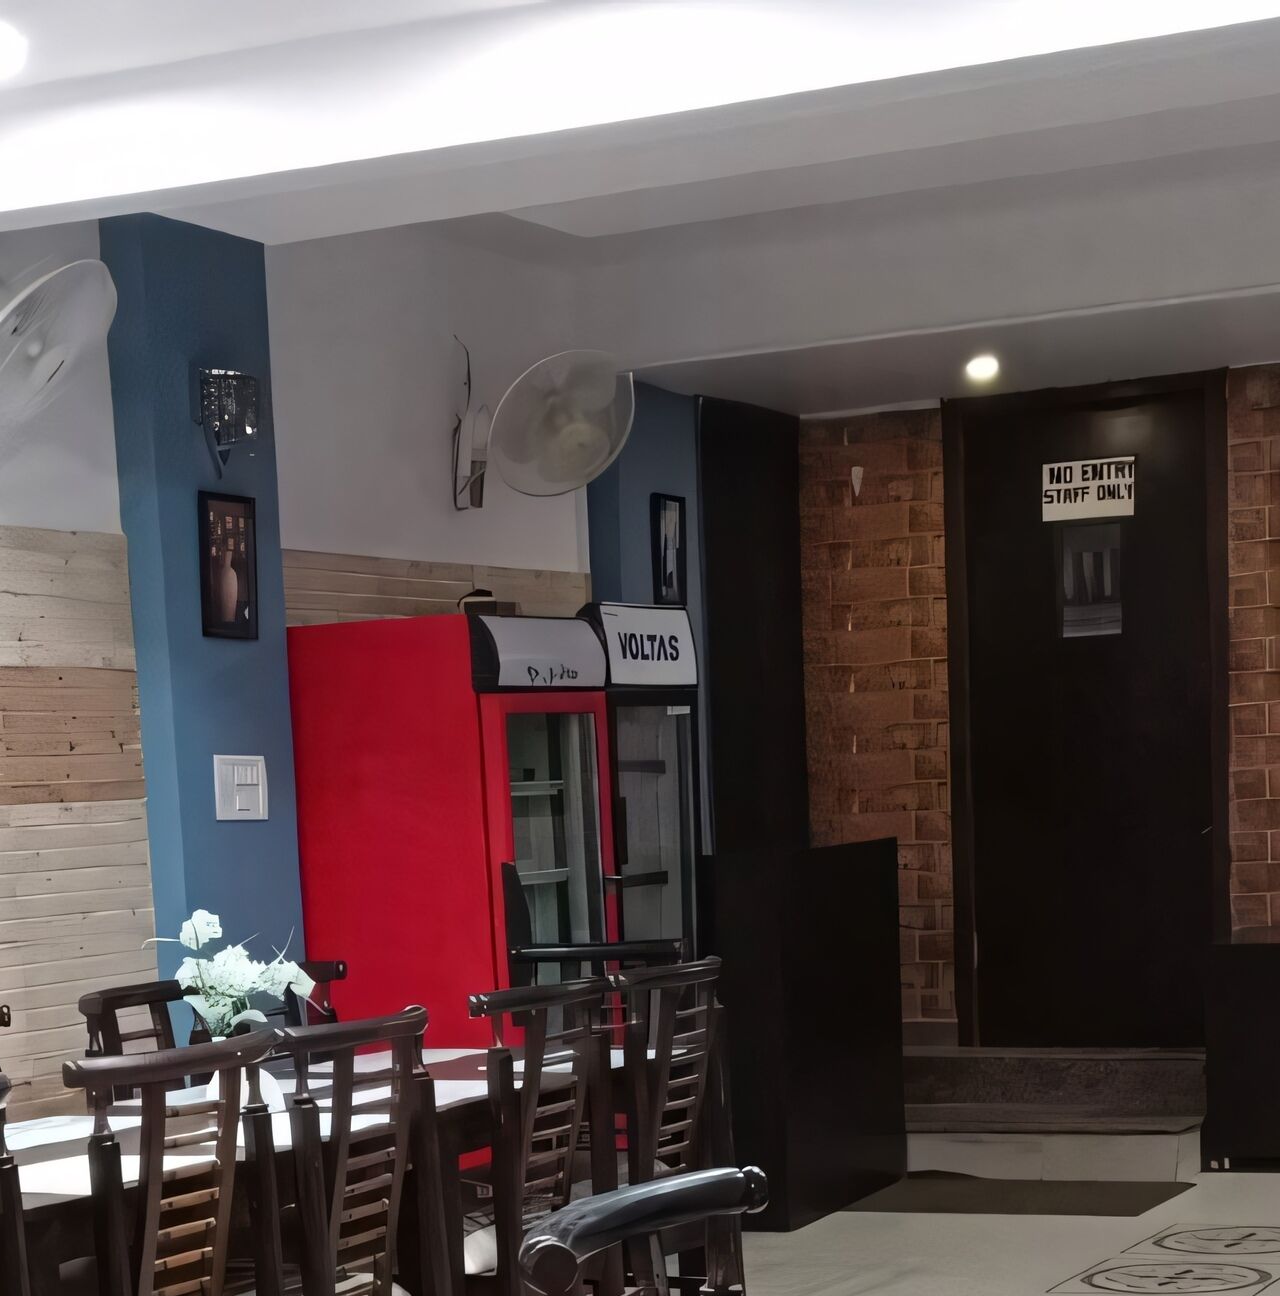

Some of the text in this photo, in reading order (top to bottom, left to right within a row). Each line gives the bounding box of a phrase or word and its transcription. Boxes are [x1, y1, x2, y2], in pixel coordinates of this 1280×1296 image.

[1049, 466, 1072, 484] NO
[1044, 486, 1090, 504] STAFF
[618, 632, 679, 661] VOLTAS
